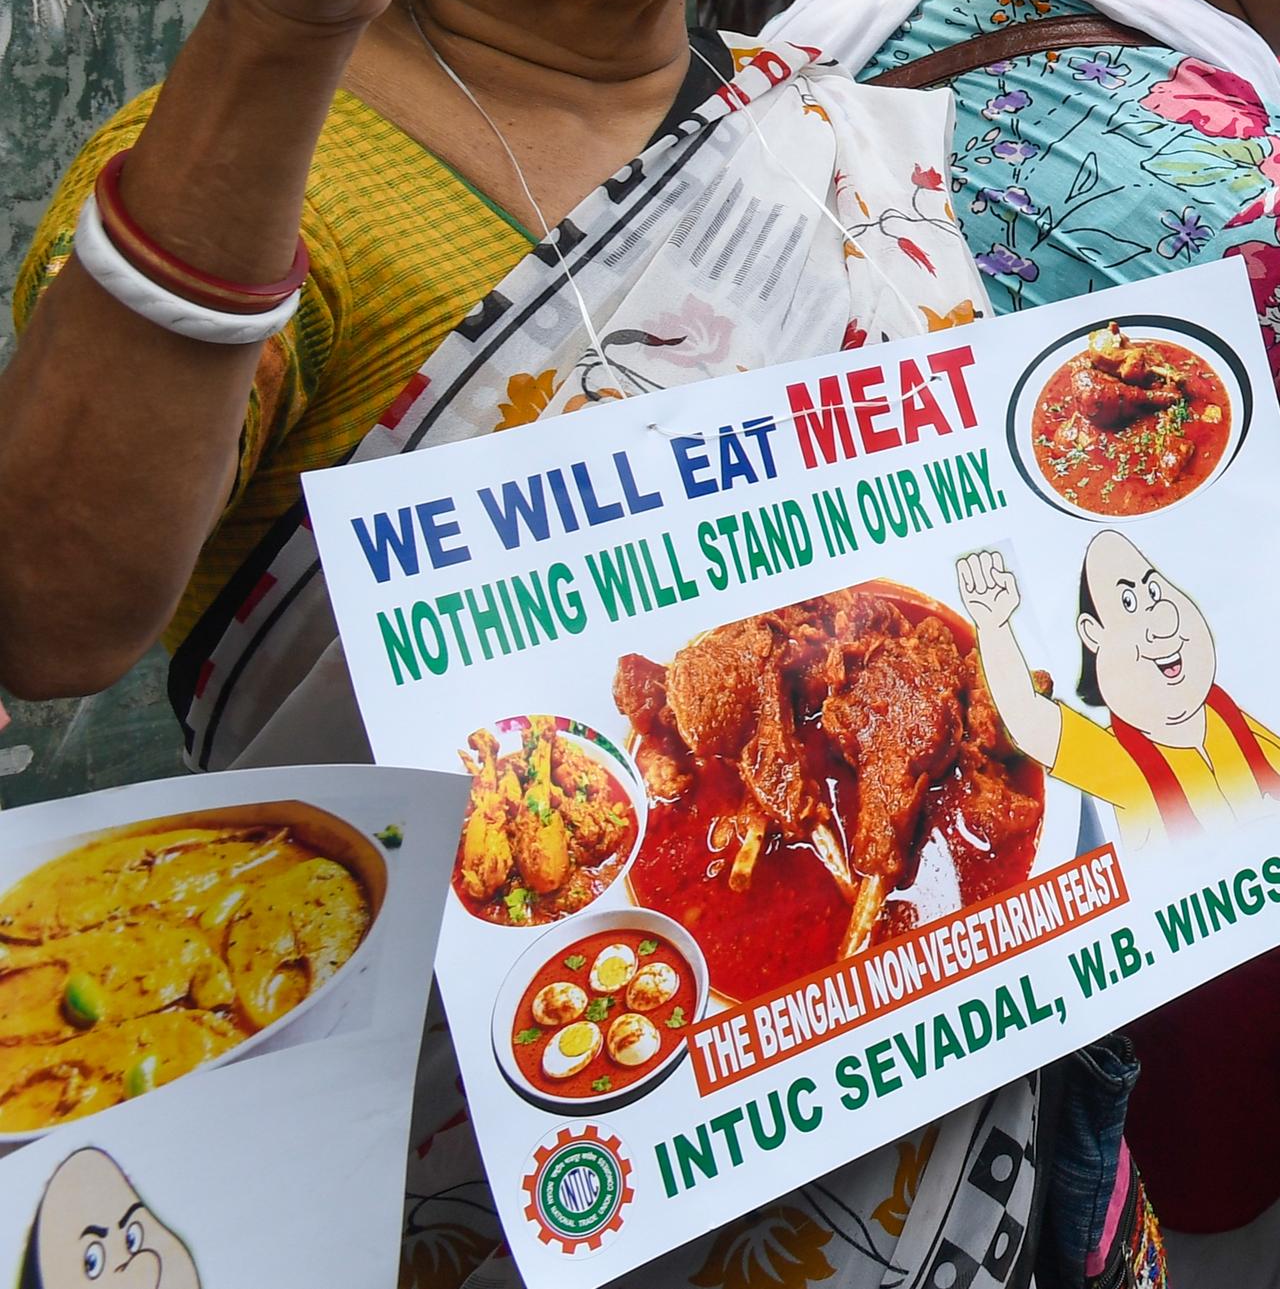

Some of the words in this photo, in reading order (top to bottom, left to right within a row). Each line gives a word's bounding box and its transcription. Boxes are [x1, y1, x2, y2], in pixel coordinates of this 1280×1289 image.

[351, 497, 472, 584] WE
[476, 450, 664, 550] WILL
[670, 415, 778, 501] EAT
[785, 344, 979, 469] MEAT
[376, 562, 587, 687] NOTHING
[584, 532, 697, 623] WILL
[697, 499, 814, 591] STAND
[813, 486, 859, 556] IN
[853, 468, 926, 546] OUR
[923, 447, 1008, 524] WAY.
[653, 1077, 824, 1199] INTUC
[835, 973, 1068, 1110] SEVADAL,
[1067, 926, 1156, 1000] W.B.
[695, 1020, 759, 1084] THE
[756, 964, 866, 1059] BENGALI
[868, 887, 1062, 1012] NON-VEGETARIAN
[1059, 856, 1121, 923] FEAST
[560, 1168, 599, 1212] INTUC
